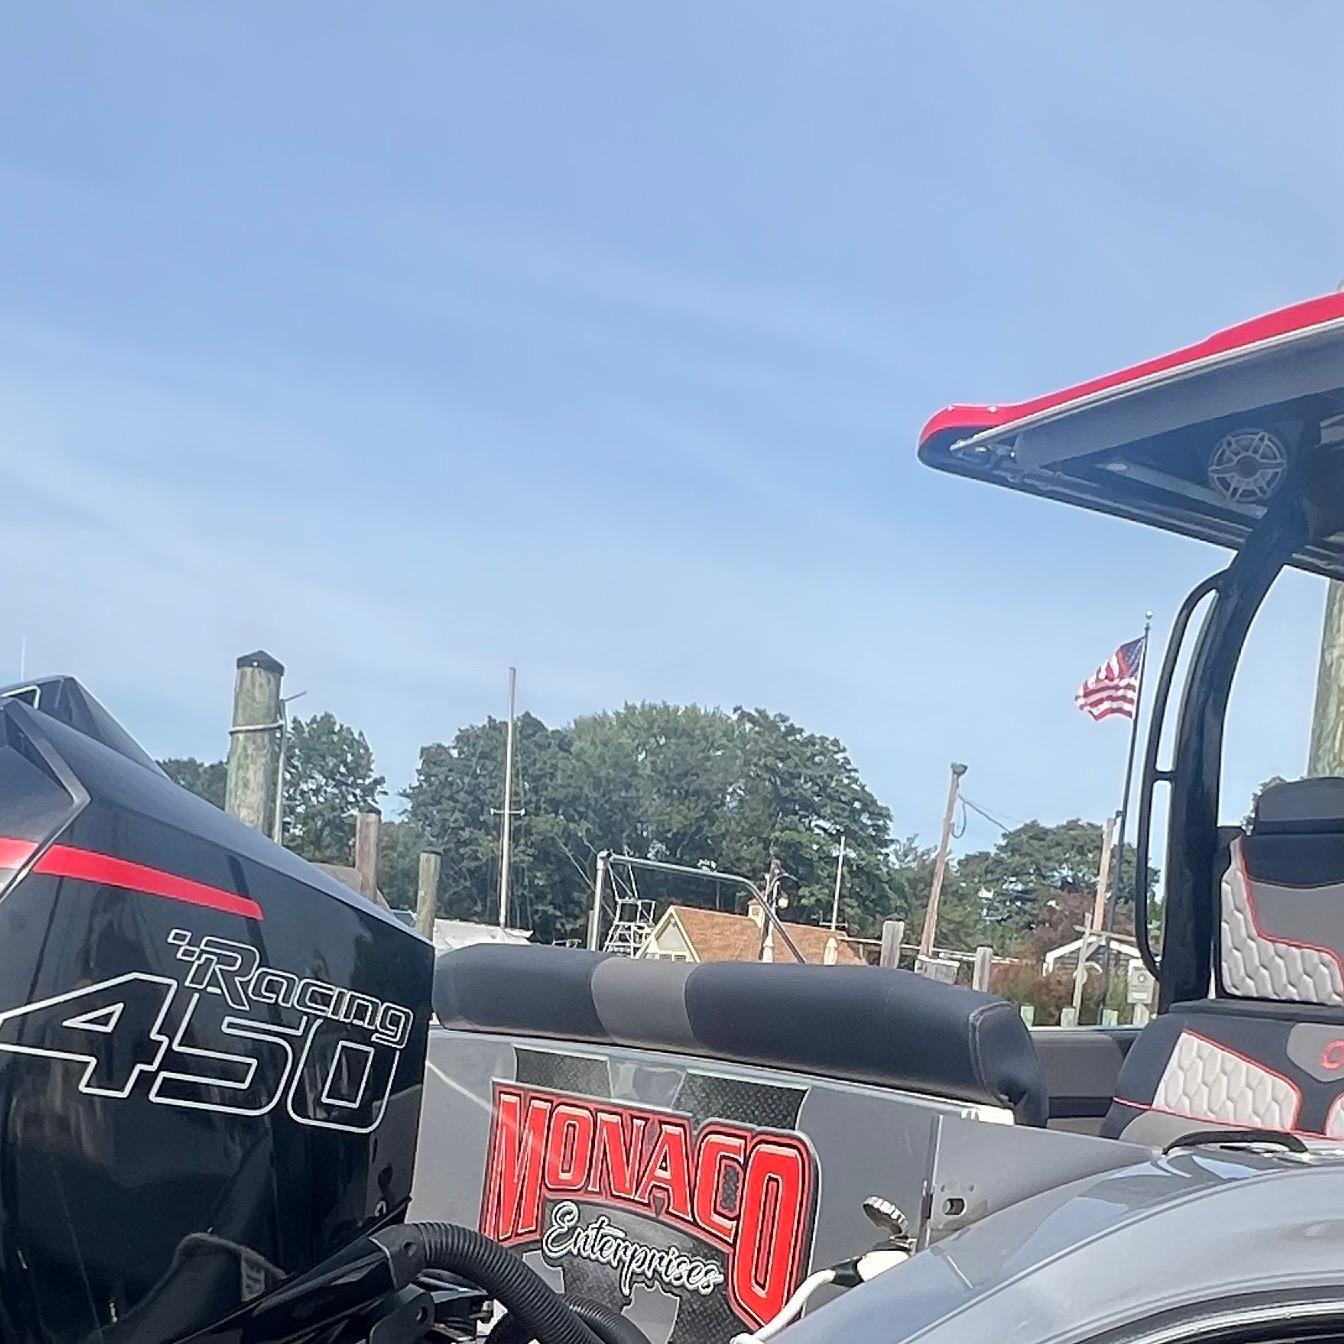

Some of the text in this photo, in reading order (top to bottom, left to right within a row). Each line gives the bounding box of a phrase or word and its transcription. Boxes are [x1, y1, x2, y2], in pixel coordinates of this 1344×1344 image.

[174, 934, 414, 1049] Racing
[486, 1092, 805, 1327] MONACO
[544, 1201, 724, 1298] Enterprises
